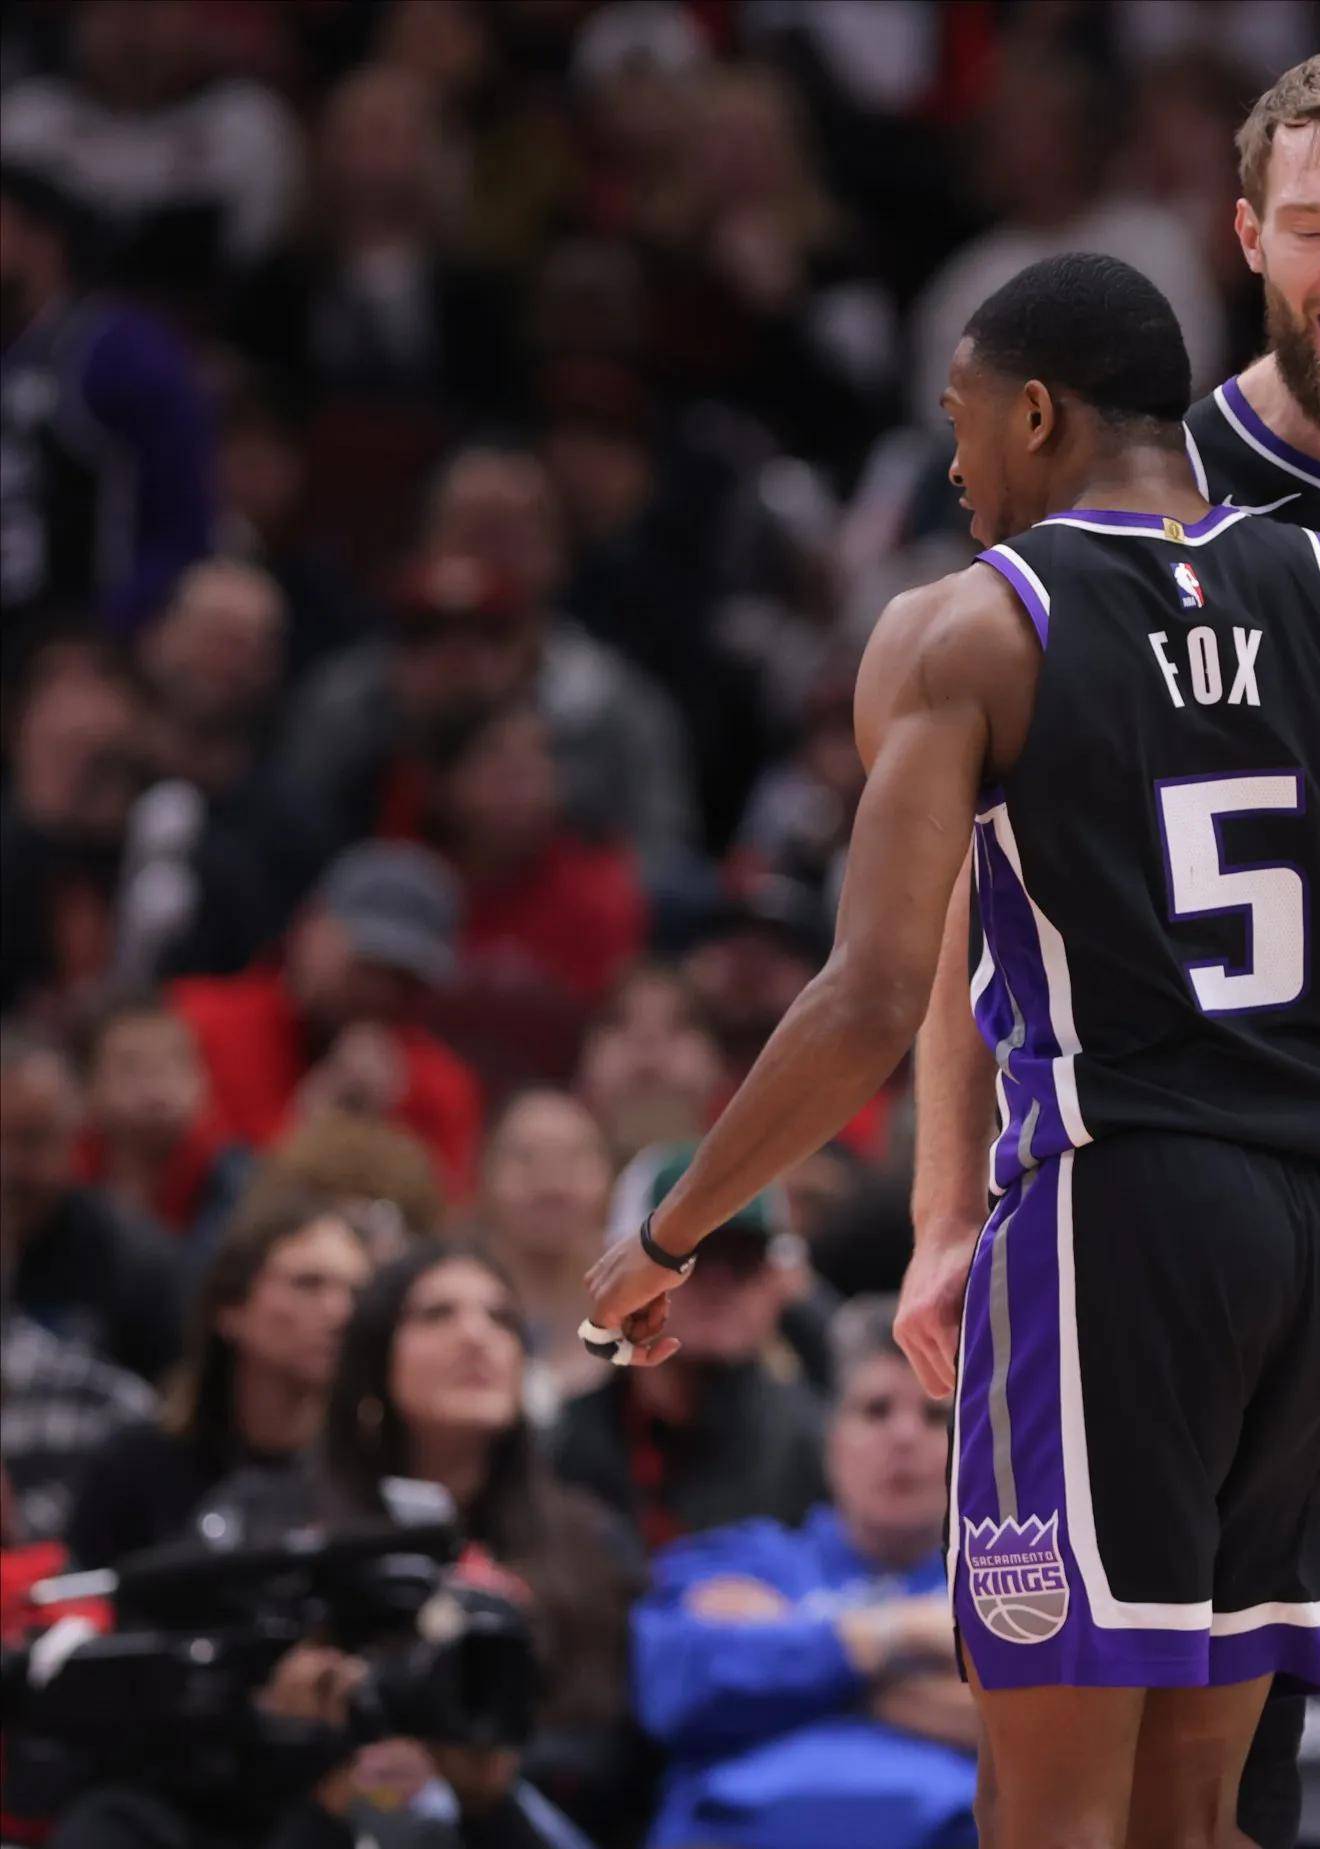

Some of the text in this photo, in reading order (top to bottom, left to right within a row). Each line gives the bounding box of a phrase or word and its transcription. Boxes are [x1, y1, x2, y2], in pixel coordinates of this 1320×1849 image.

[1148, 626, 1263, 708] FOX
[1155, 769, 1311, 1017] 5
[972, 1551, 1053, 1567] SACRAMENTO
[973, 1565, 1065, 1597] KINGS
